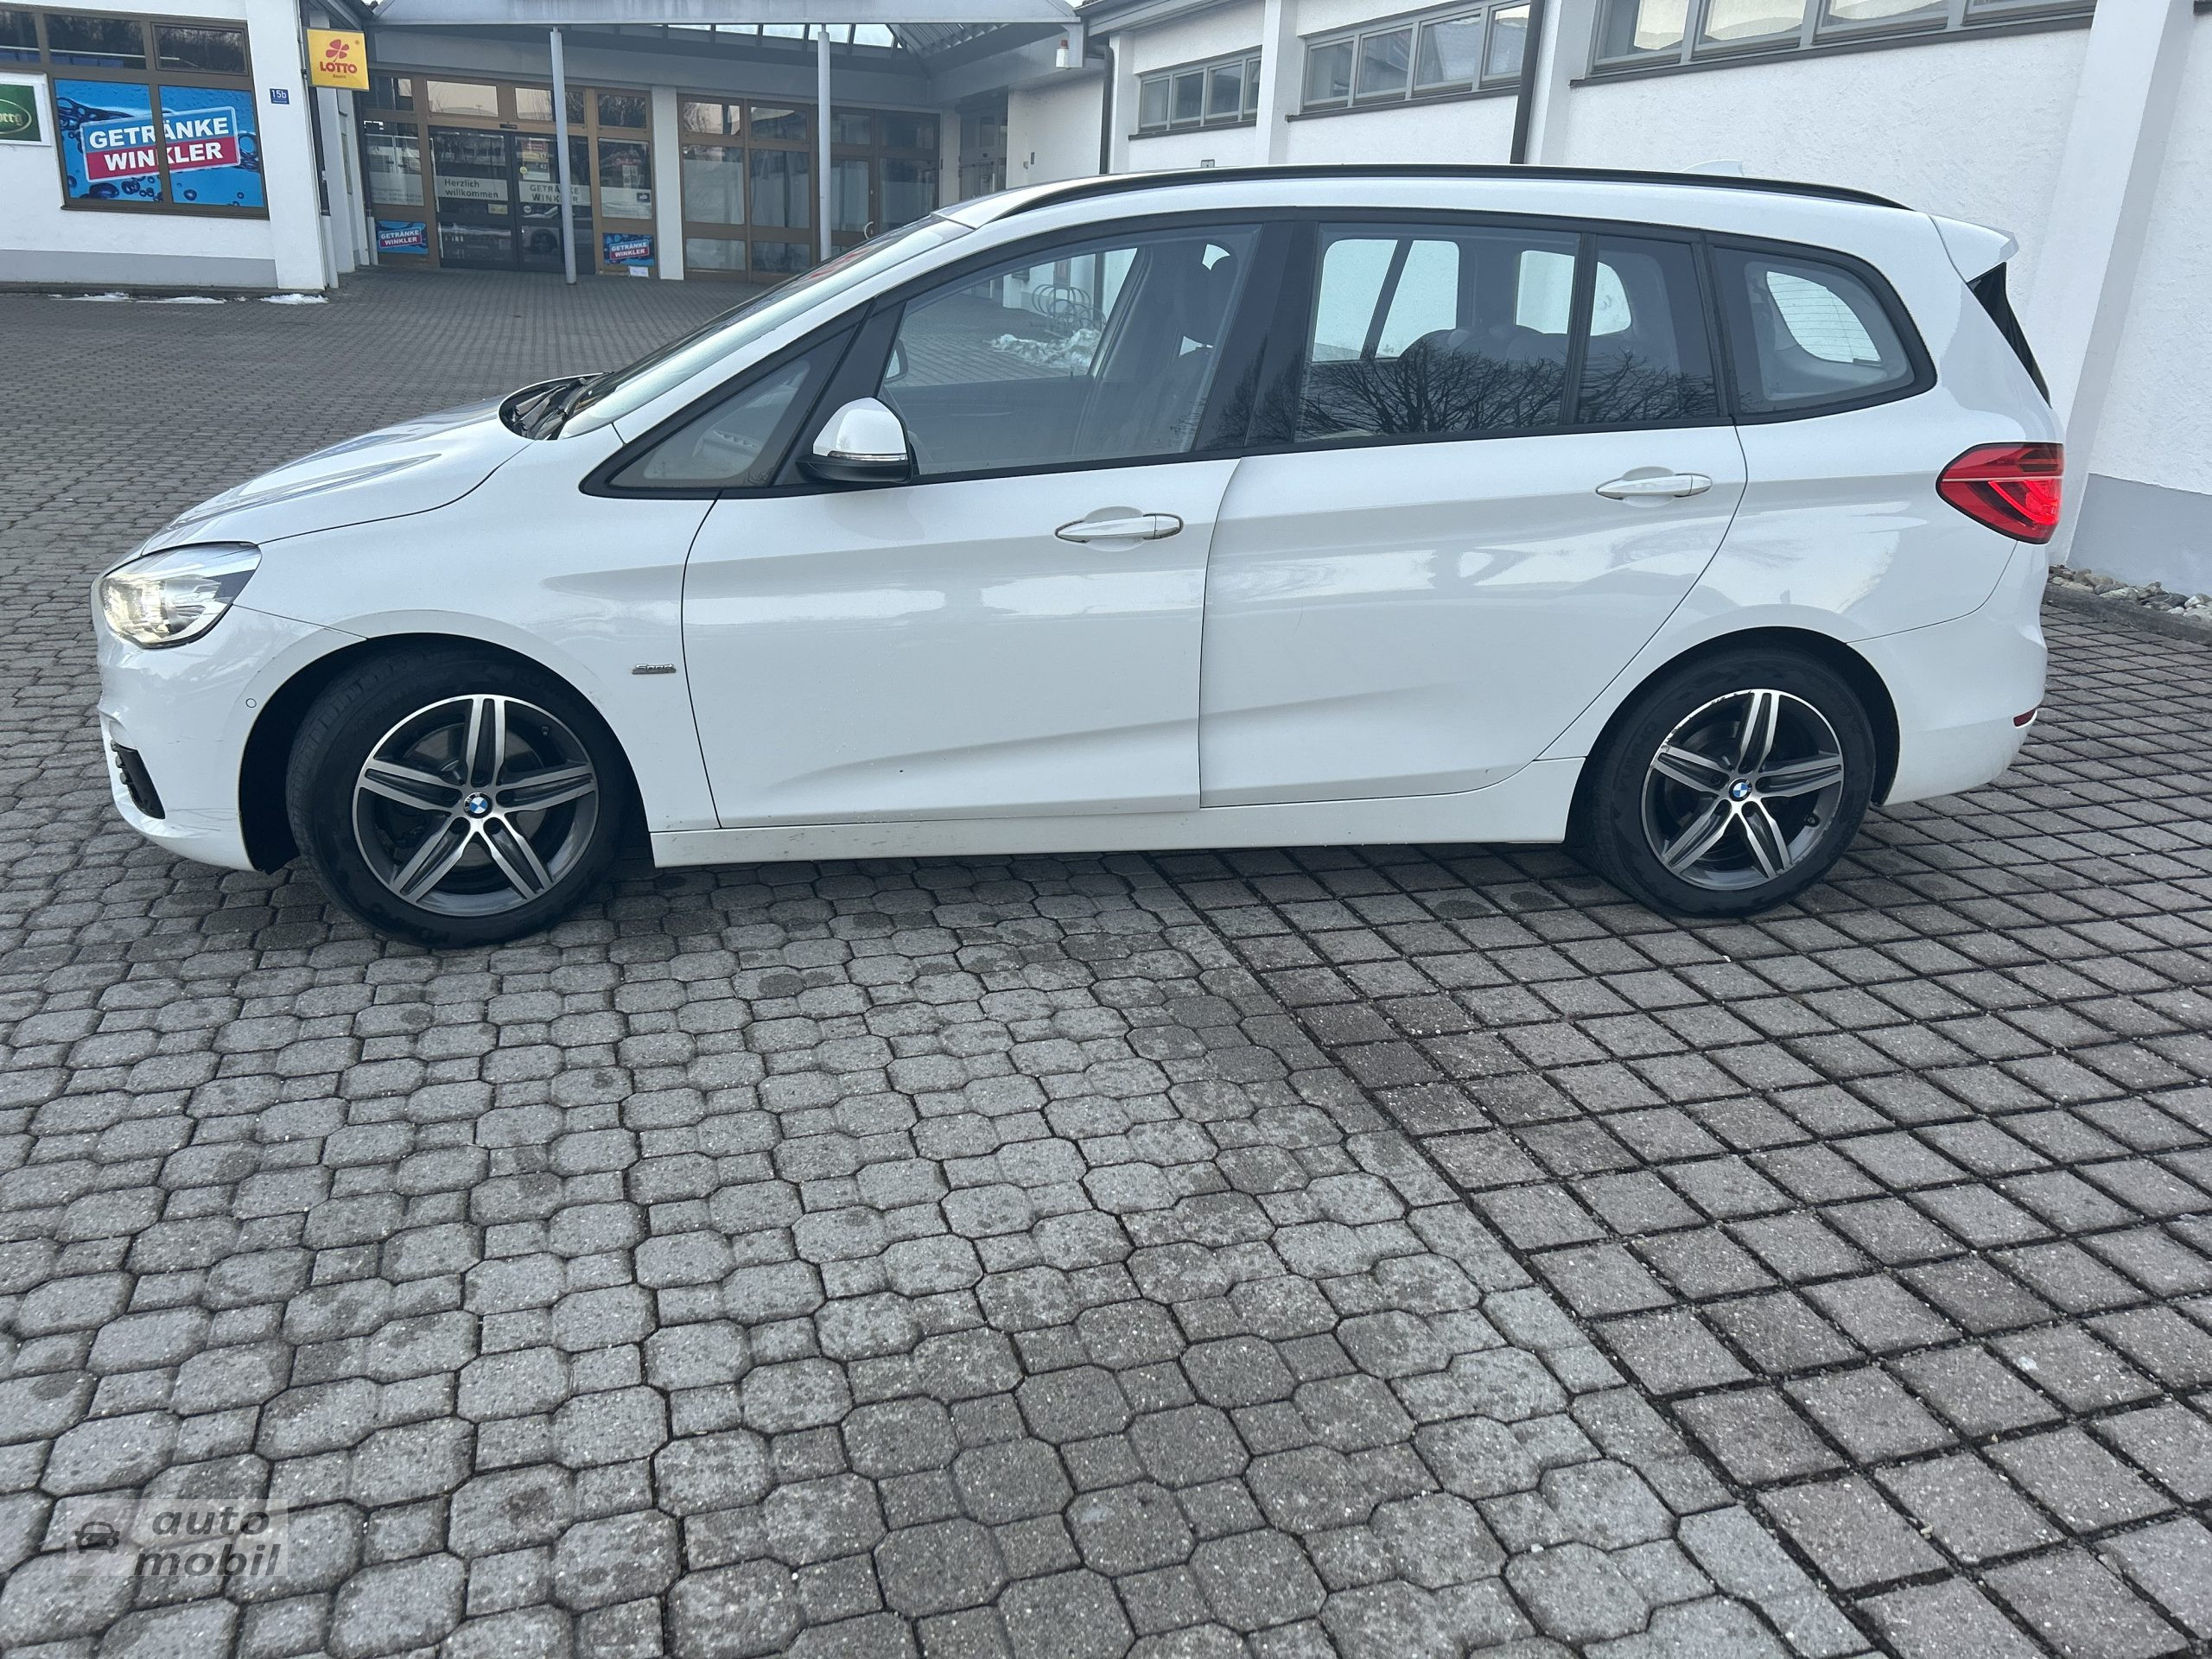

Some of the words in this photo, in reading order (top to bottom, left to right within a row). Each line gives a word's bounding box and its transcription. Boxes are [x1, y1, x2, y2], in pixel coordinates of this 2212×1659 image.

[319, 61, 358, 74] LOTTO
[272, 89, 287, 99] 15b
[89, 117, 229, 149] GETRÄNKE
[444, 178, 480, 188] Herzlich
[445, 188, 499, 199] willkommen
[385, 236, 417, 246] WINKLER
[614, 248, 645, 258] WINKLER
